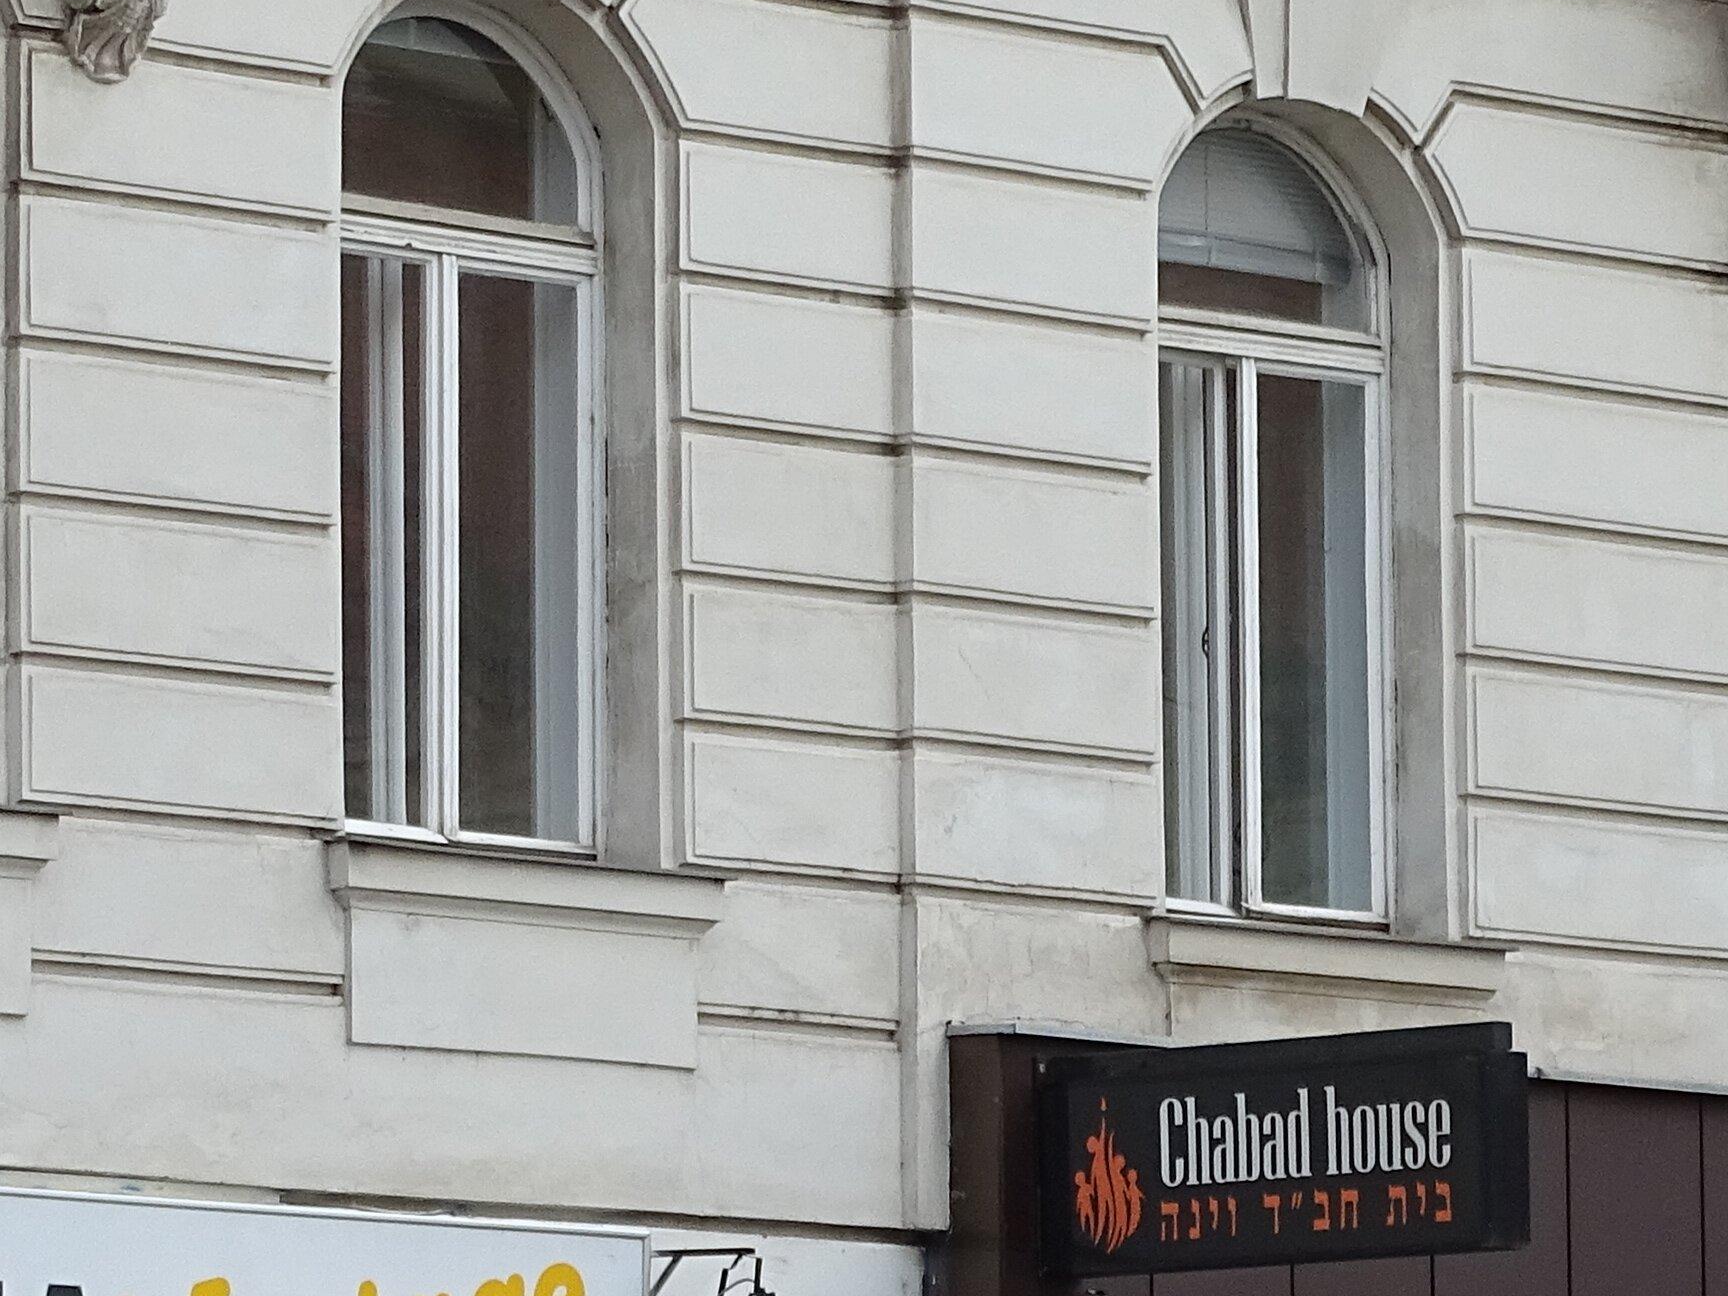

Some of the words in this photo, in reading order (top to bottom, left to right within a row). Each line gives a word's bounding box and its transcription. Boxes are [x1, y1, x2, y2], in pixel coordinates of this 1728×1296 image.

[1159, 1087, 1313, 1188] Chabad
[1324, 1085, 1451, 1176] house
[1161, 1195, 1237, 1241] וינה
[1386, 1179, 1453, 1227] בית
